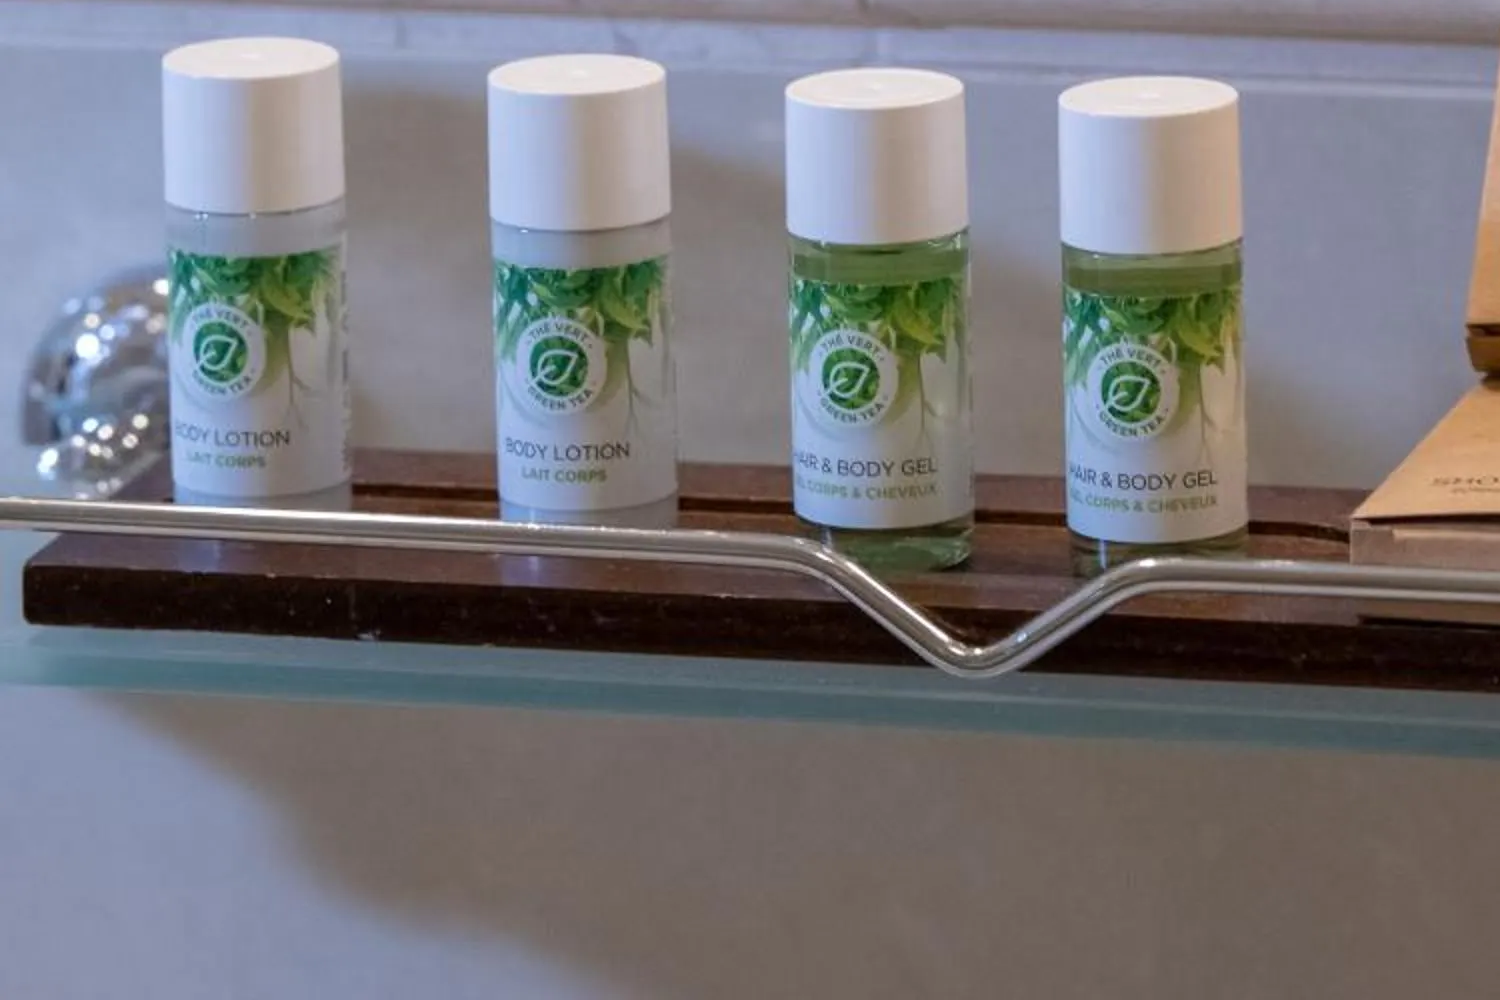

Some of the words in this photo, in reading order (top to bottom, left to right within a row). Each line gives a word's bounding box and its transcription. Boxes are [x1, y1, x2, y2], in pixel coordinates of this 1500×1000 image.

[568, 388, 593, 408] TEA
[859, 402, 885, 421] TEA
[1140, 415, 1166, 435] TEA
[214, 428, 291, 449] LOTION
[506, 436, 549, 460] BODY
[553, 441, 631, 463] LOTION
[214, 455, 266, 469] CORPS
[821, 457, 833, 475] &
[837, 458, 896, 478] BODY
[901, 456, 939, 477] GEL
[521, 466, 551, 483] LAIT
[554, 467, 608, 483] CORPS
[1100, 470, 1114, 489] &
[1117, 472, 1179, 492] BODY
[1182, 469, 1219, 490] GEL
[865, 482, 939, 501] CHEVEUX
[1147, 495, 1219, 514] CHEVEUX
